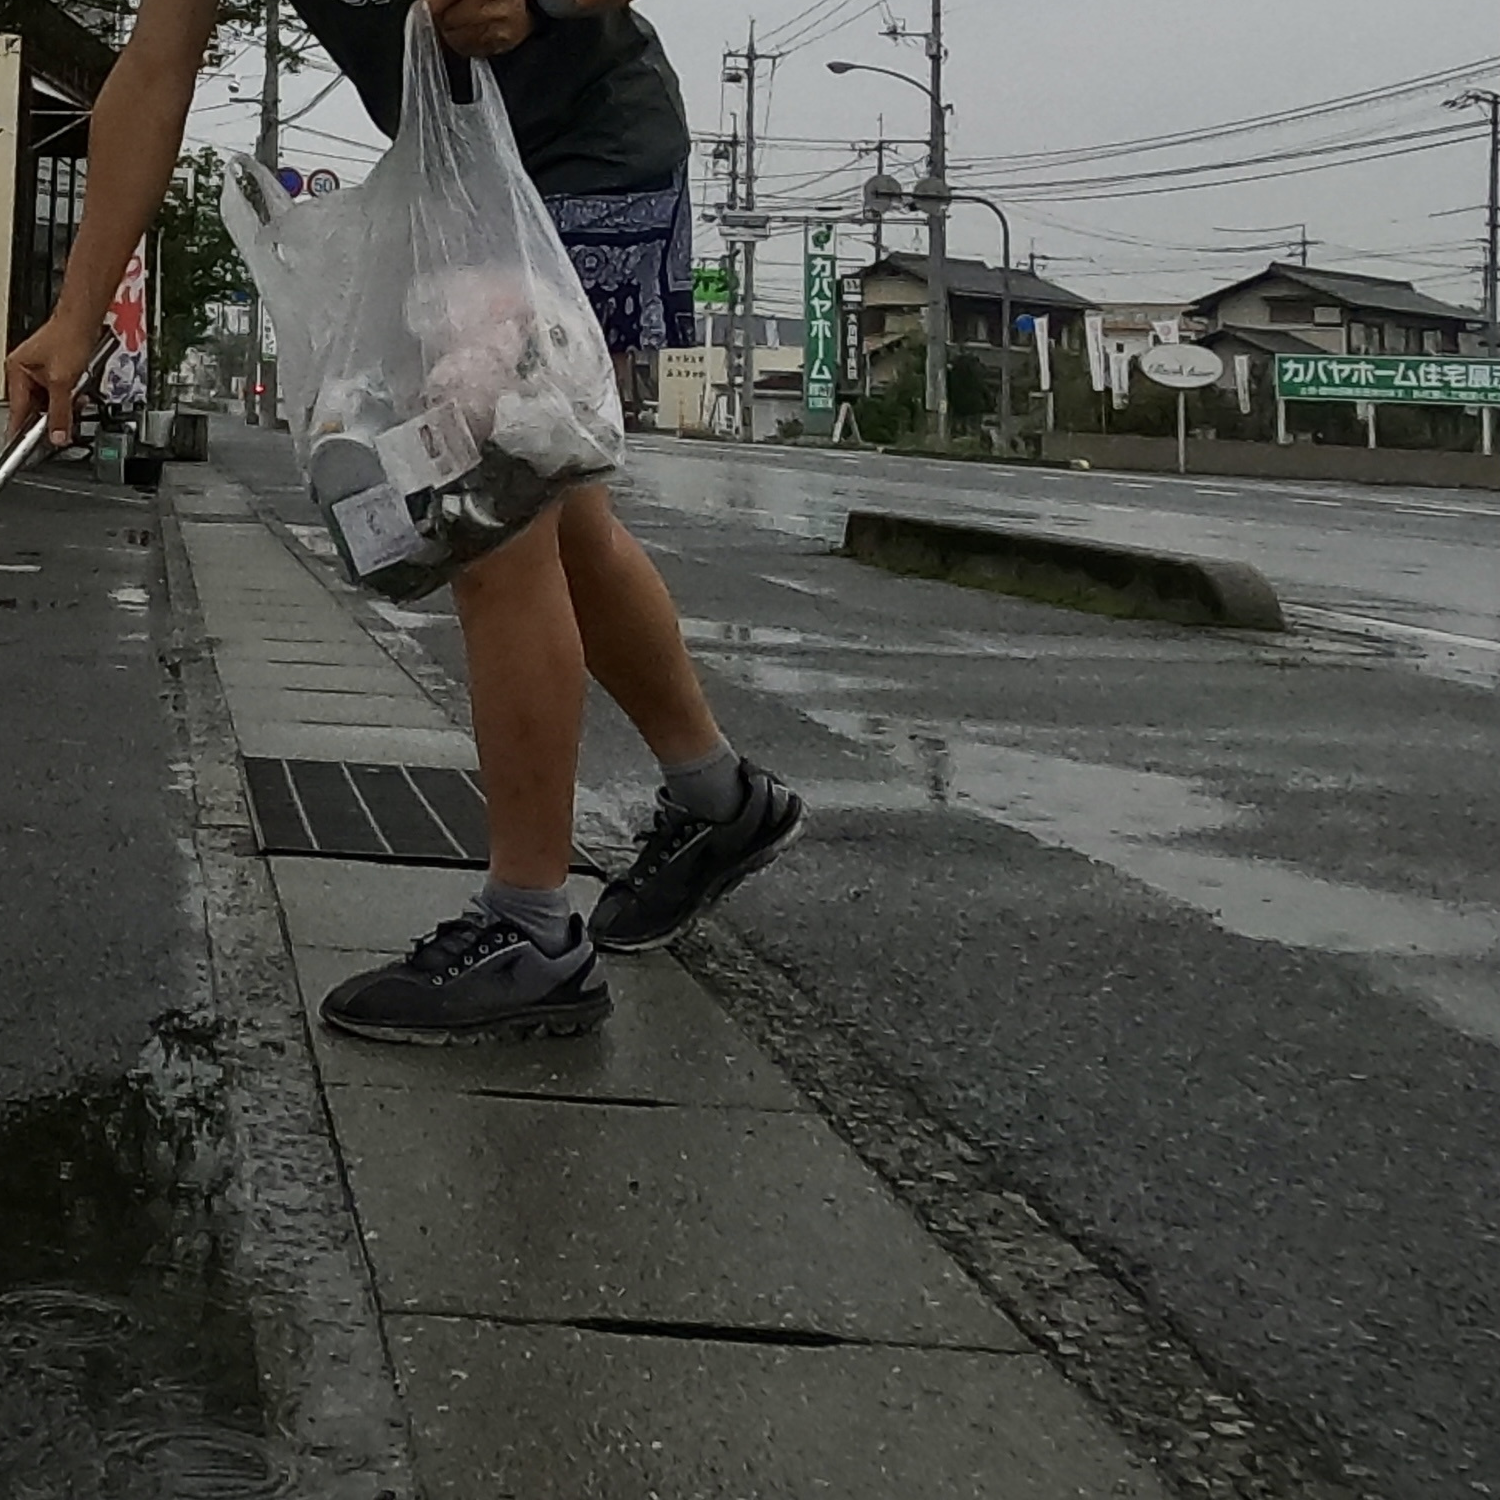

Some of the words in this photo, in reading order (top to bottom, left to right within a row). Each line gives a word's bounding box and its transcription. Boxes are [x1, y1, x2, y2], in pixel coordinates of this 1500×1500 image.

[314, 177, 333, 193] 50
[810, 257, 832, 379] カバヤホーム
